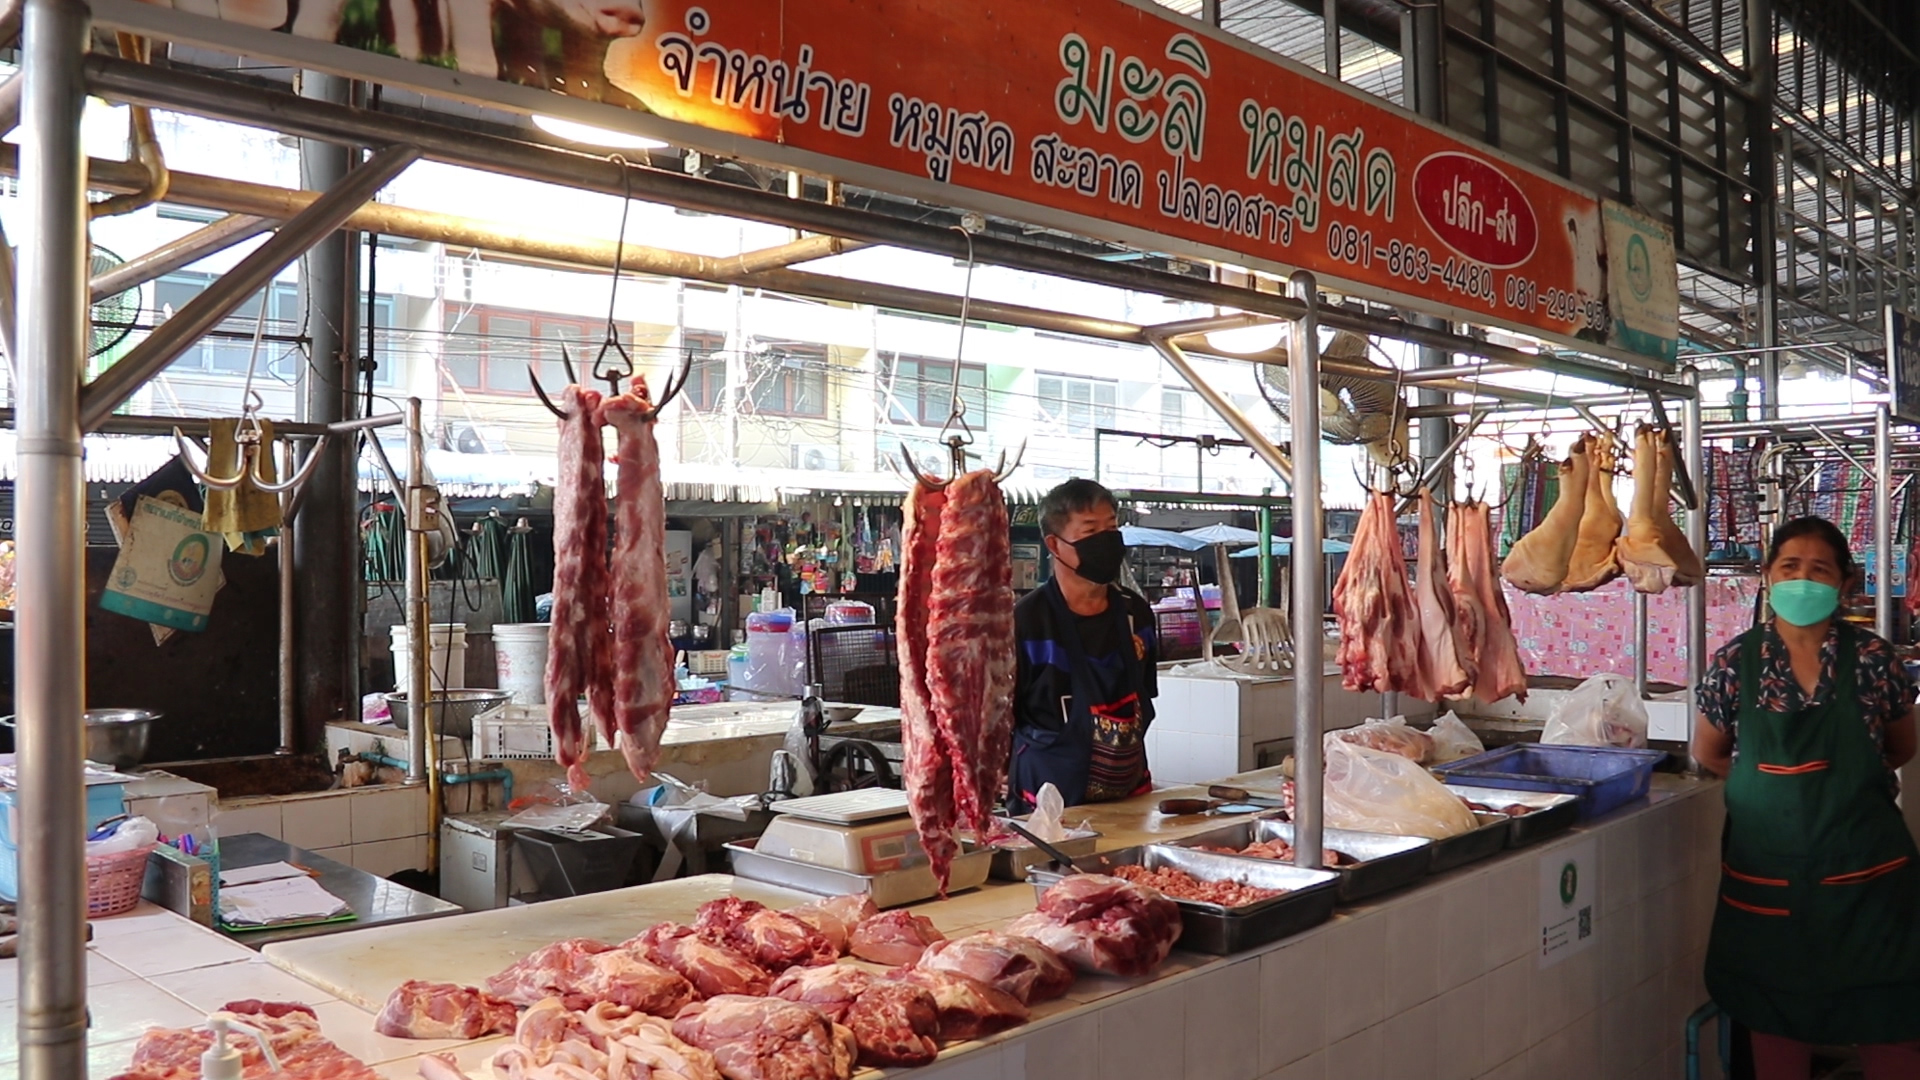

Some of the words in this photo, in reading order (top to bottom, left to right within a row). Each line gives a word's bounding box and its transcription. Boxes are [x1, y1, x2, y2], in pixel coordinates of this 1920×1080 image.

[656, 8, 869, 136] จำหน่าย
[890, 94, 1013, 183] หมูสด
[1032, 133, 1142, 207] สะอาด
[1159, 156, 1293, 245] ปลอดสาร
[1328, 221, 1496, 307] 081-863-4480,
[1056, 34, 1210, 159] มะลิ
[1241, 100, 1395, 231] หมูสด
[1442, 174, 1517, 246] ปลีก-ส่ง
